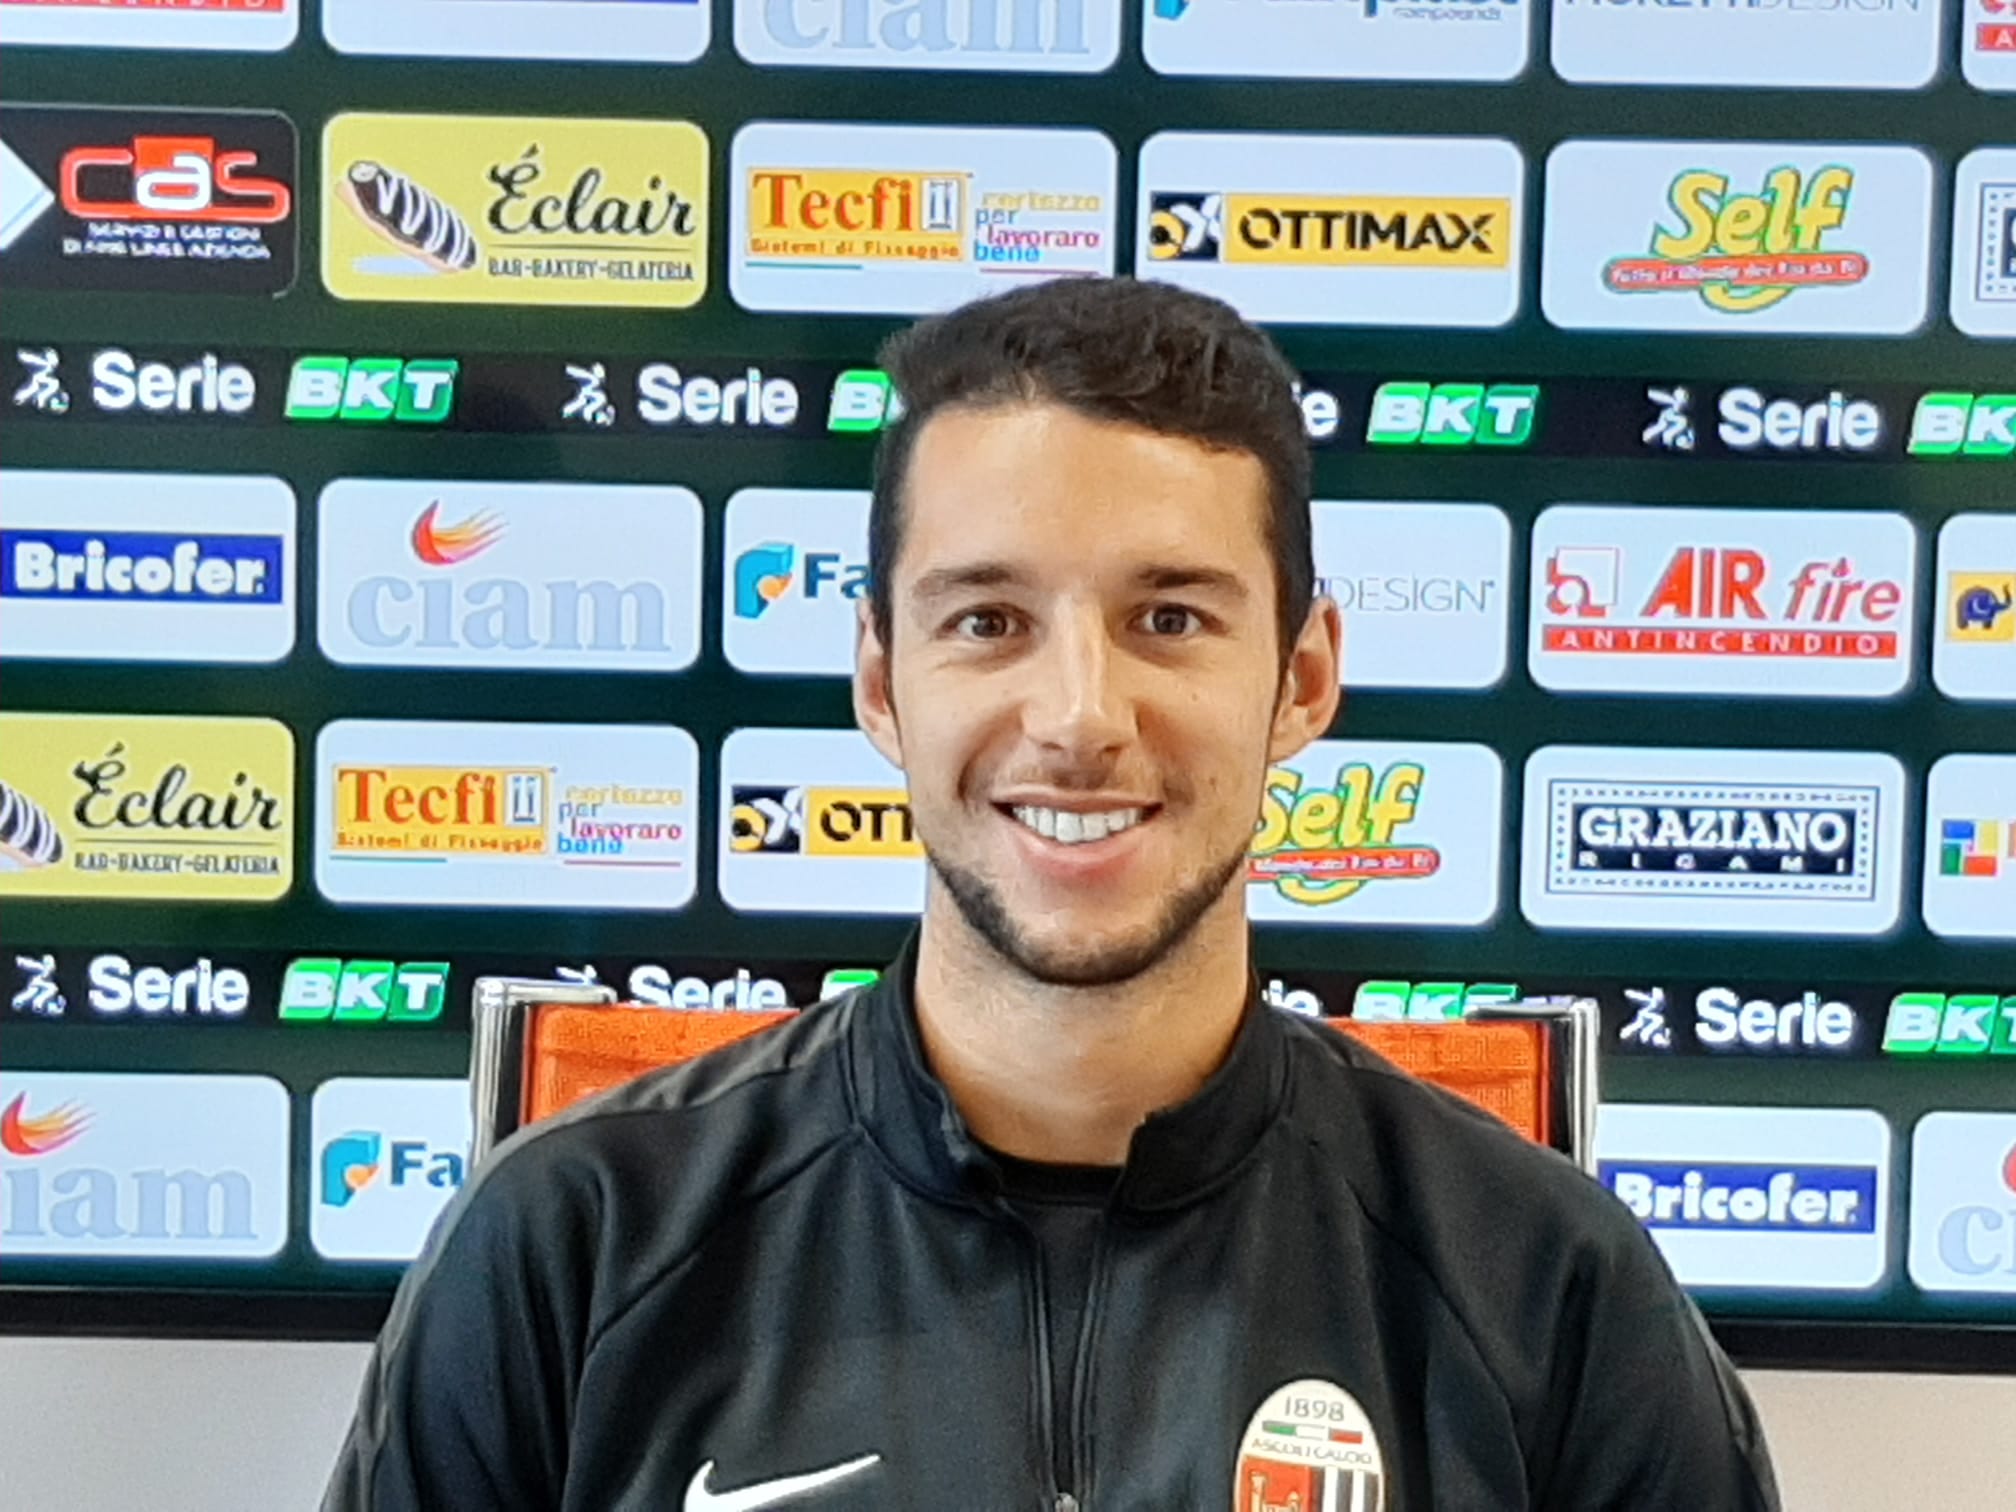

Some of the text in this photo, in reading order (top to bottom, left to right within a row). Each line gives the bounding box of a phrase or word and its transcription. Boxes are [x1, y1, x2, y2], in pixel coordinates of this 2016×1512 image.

[487, 142, 696, 236] Éclair
[1650, 164, 1854, 260] Self
[1239, 207, 1496, 254] OTTIMAX
[93, 349, 256, 412] Serie
[287, 364, 455, 414] BKT
[638, 362, 798, 424] Serie
[1371, 389, 1536, 439] BKT
[1718, 387, 1878, 448] Serie
[347, 575, 671, 651] ciam
[1640, 547, 1900, 622] AIR fire
[1562, 629, 1880, 655] ANTINCENDIO
[73, 741, 282, 830] Éclair
[1250, 762, 1424, 853] Self
[1578, 807, 1847, 853] GRAZIANO
[88, 954, 250, 1013] Serie
[283, 966, 446, 1015] BKT
[1695, 986, 1854, 1045] Serie
[1285, 1396, 1345, 1422] 1898
